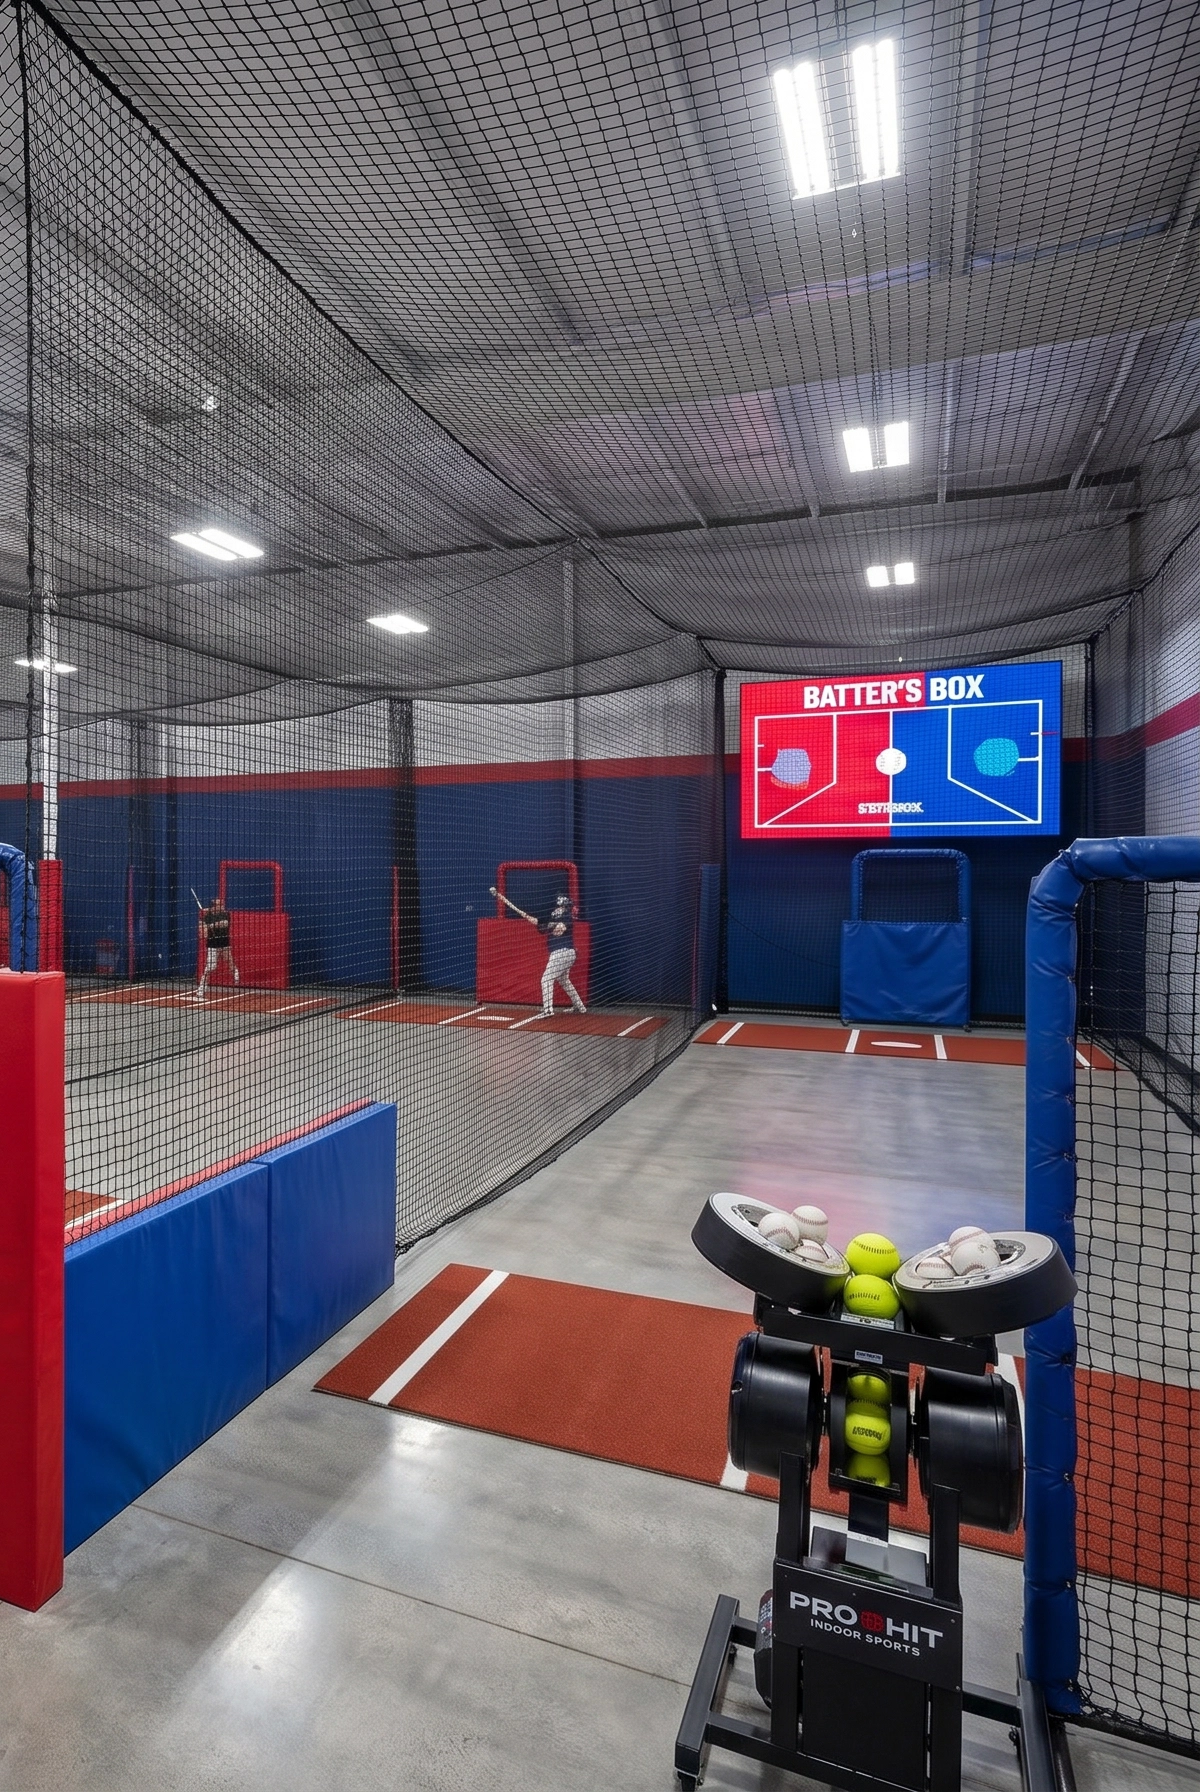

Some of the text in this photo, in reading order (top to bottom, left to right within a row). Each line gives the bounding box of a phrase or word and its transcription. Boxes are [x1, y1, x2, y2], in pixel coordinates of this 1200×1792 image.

[803, 674, 984, 709] BATTER'S BOX
[790, 1591, 858, 1626] PRO
[886, 1617, 943, 1649] HIT
[810, 1618, 921, 1657] INDOOR SPORTS
